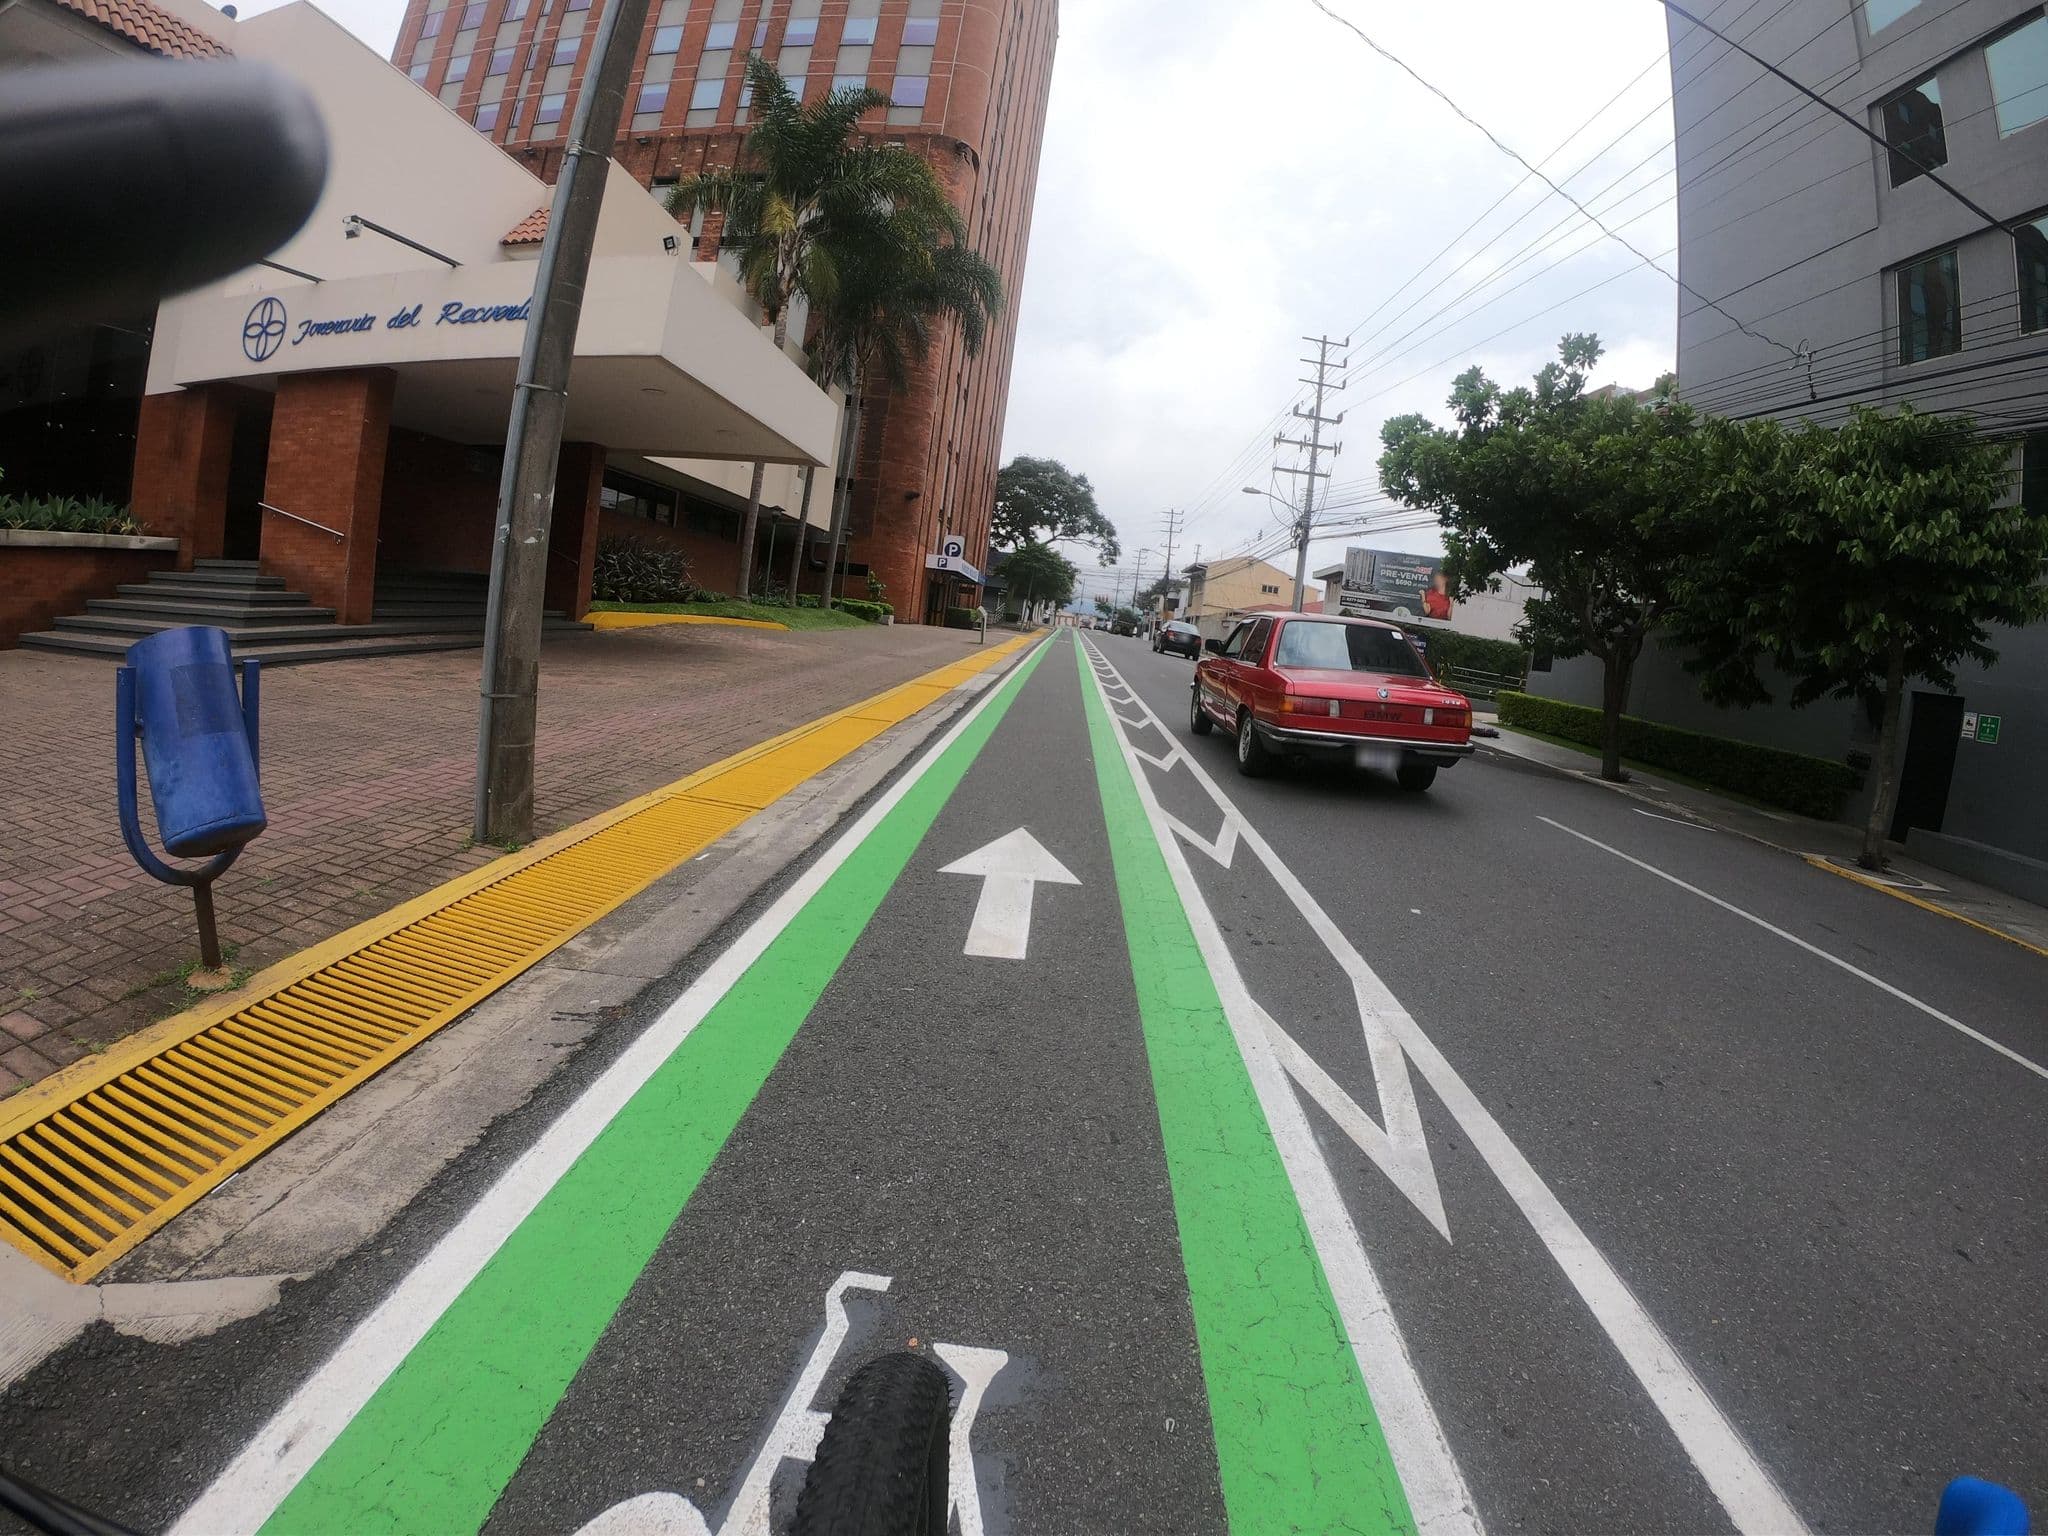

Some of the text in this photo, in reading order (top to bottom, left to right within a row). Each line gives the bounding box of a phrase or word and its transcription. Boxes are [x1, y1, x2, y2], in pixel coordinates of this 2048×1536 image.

[292, 313, 376, 345] Funeraria
[386, 304, 423, 329] del
[1380, 569, 1429, 582] PRE-VENTA
